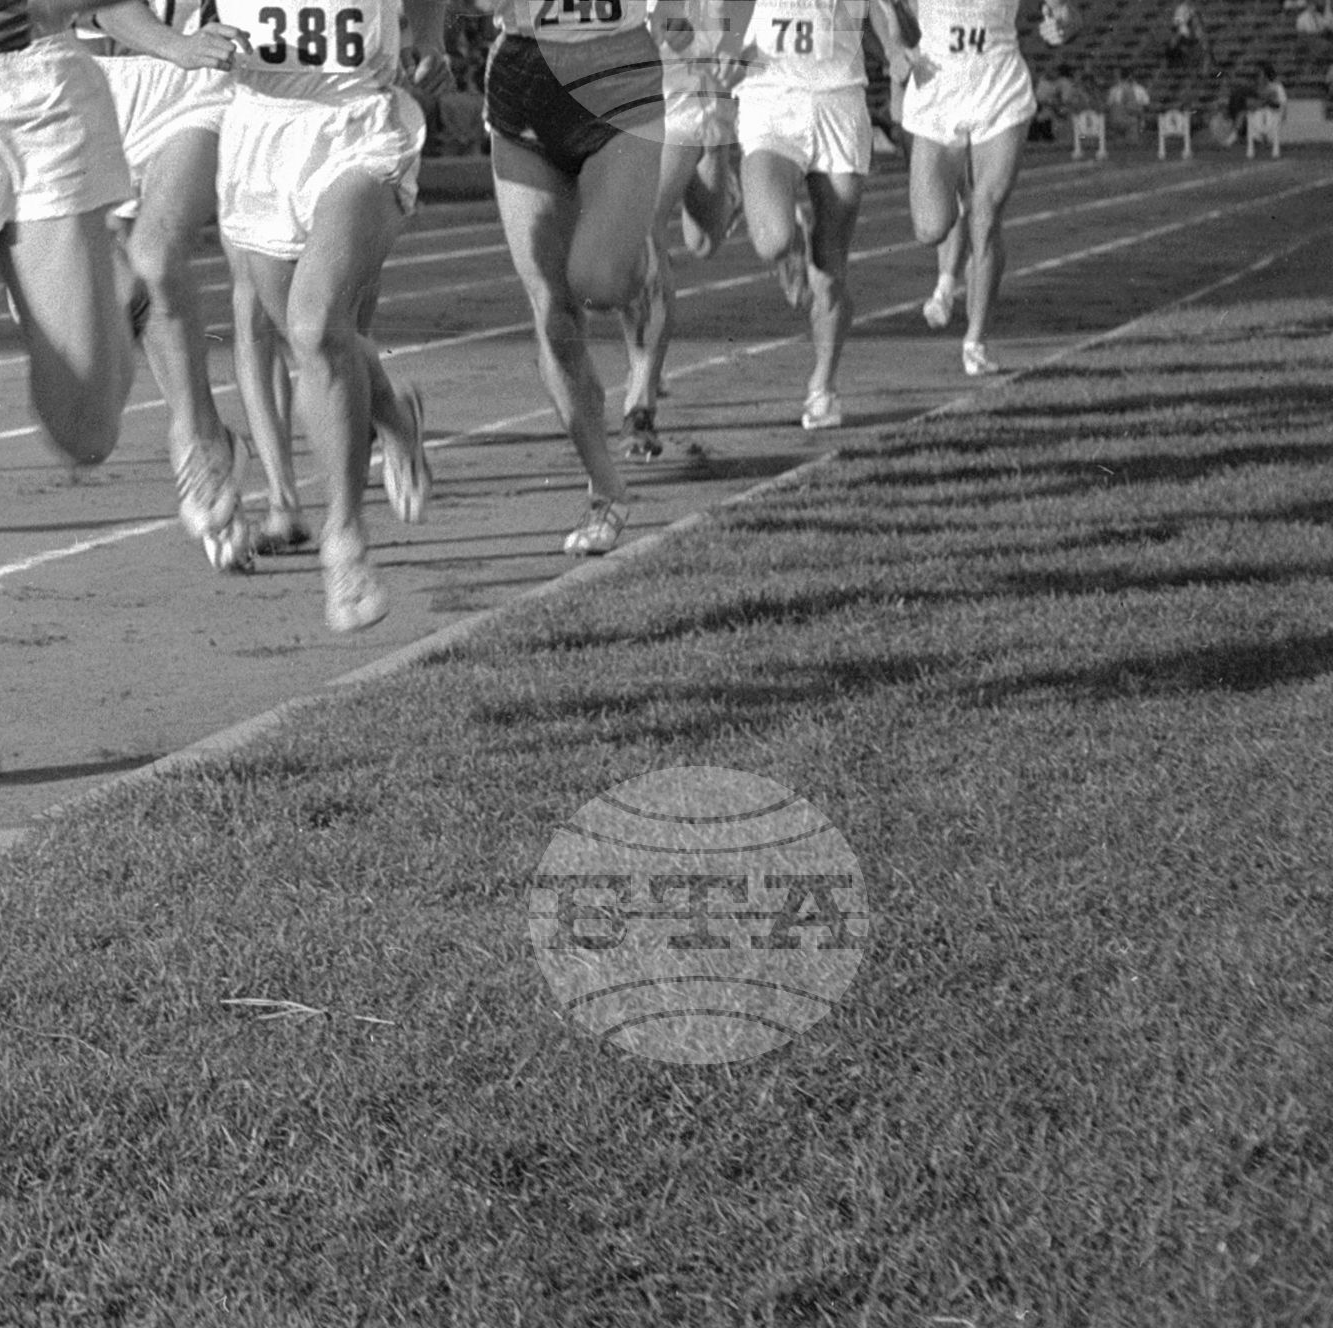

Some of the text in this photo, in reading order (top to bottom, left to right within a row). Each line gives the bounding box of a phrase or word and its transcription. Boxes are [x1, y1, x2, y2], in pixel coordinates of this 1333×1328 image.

[259, 7, 365, 67] 386
[772, 18, 813, 54] 78
[949, 25, 986, 54] 34
